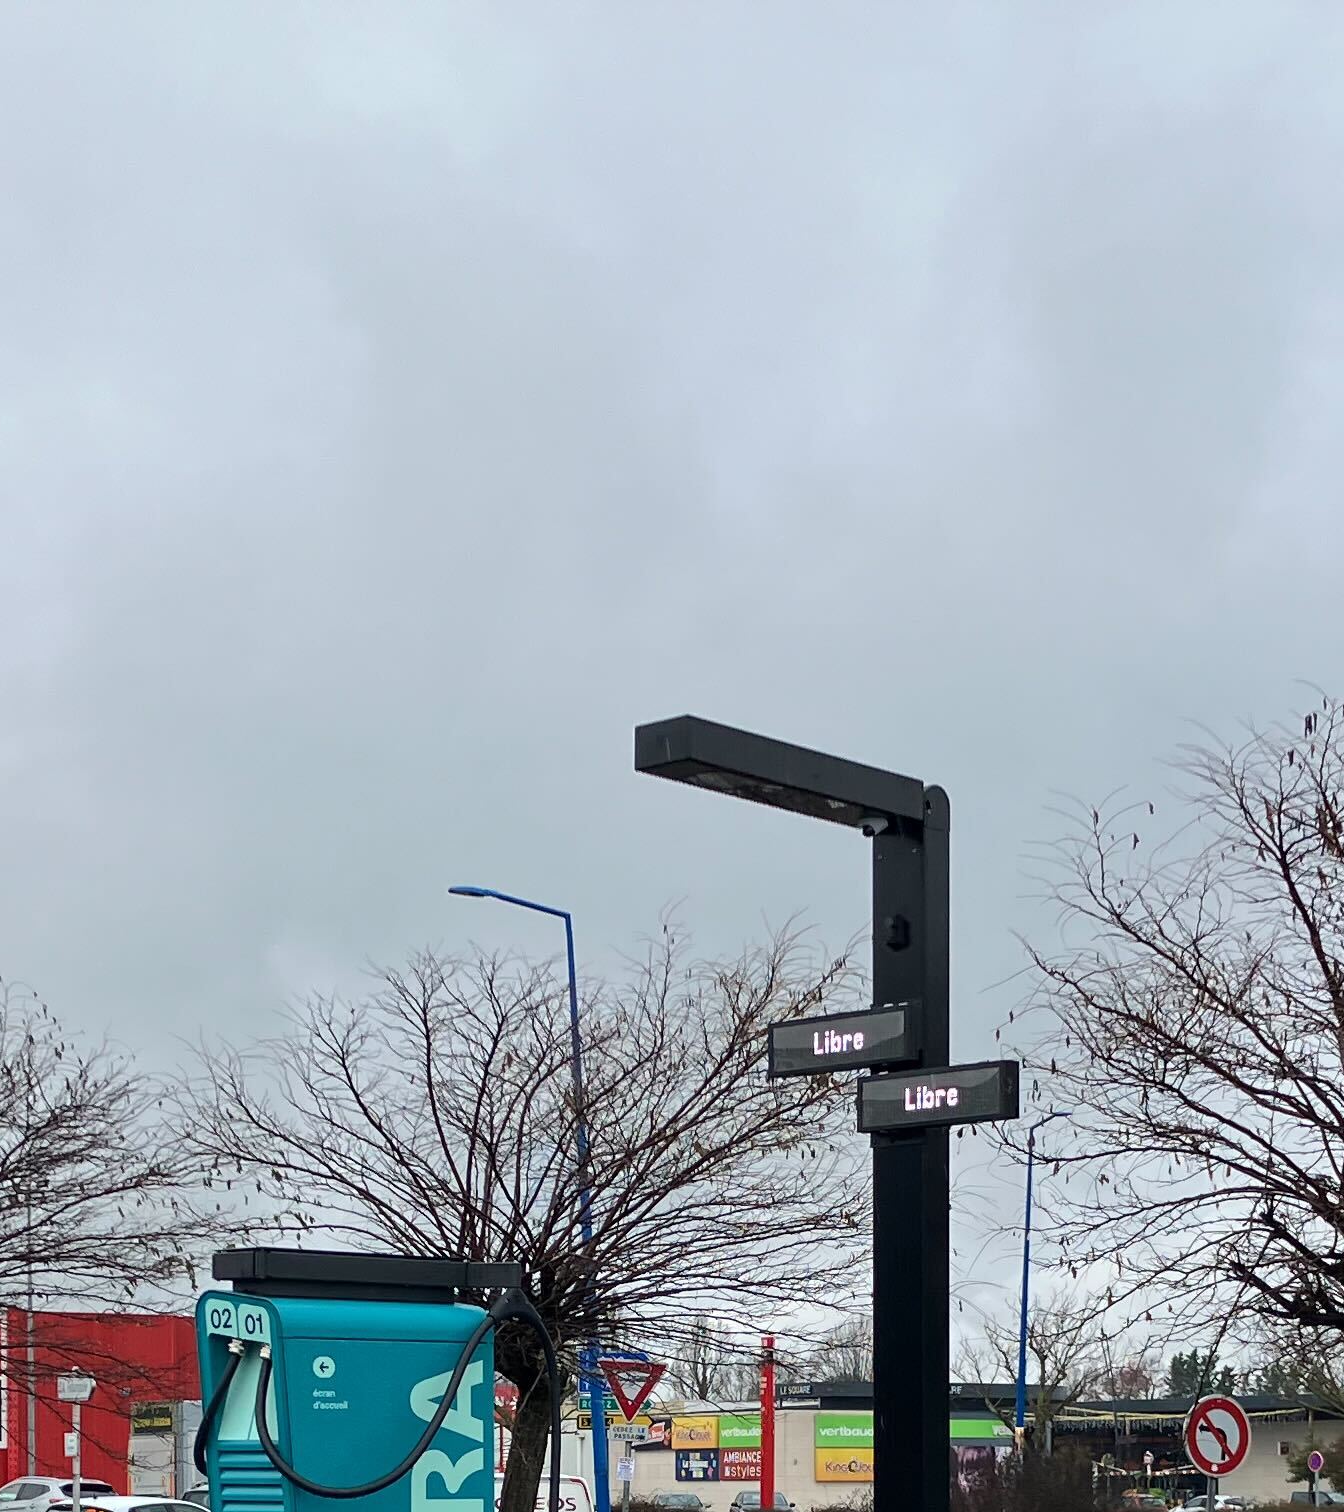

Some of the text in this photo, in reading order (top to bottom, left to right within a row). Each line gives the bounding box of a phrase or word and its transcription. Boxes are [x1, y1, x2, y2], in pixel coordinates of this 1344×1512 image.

[812, 1027, 865, 1056] Libre
[904, 1085, 959, 1112] Libre
[210, 1308, 233, 1329] 02
[244, 1313, 264, 1335] 01
